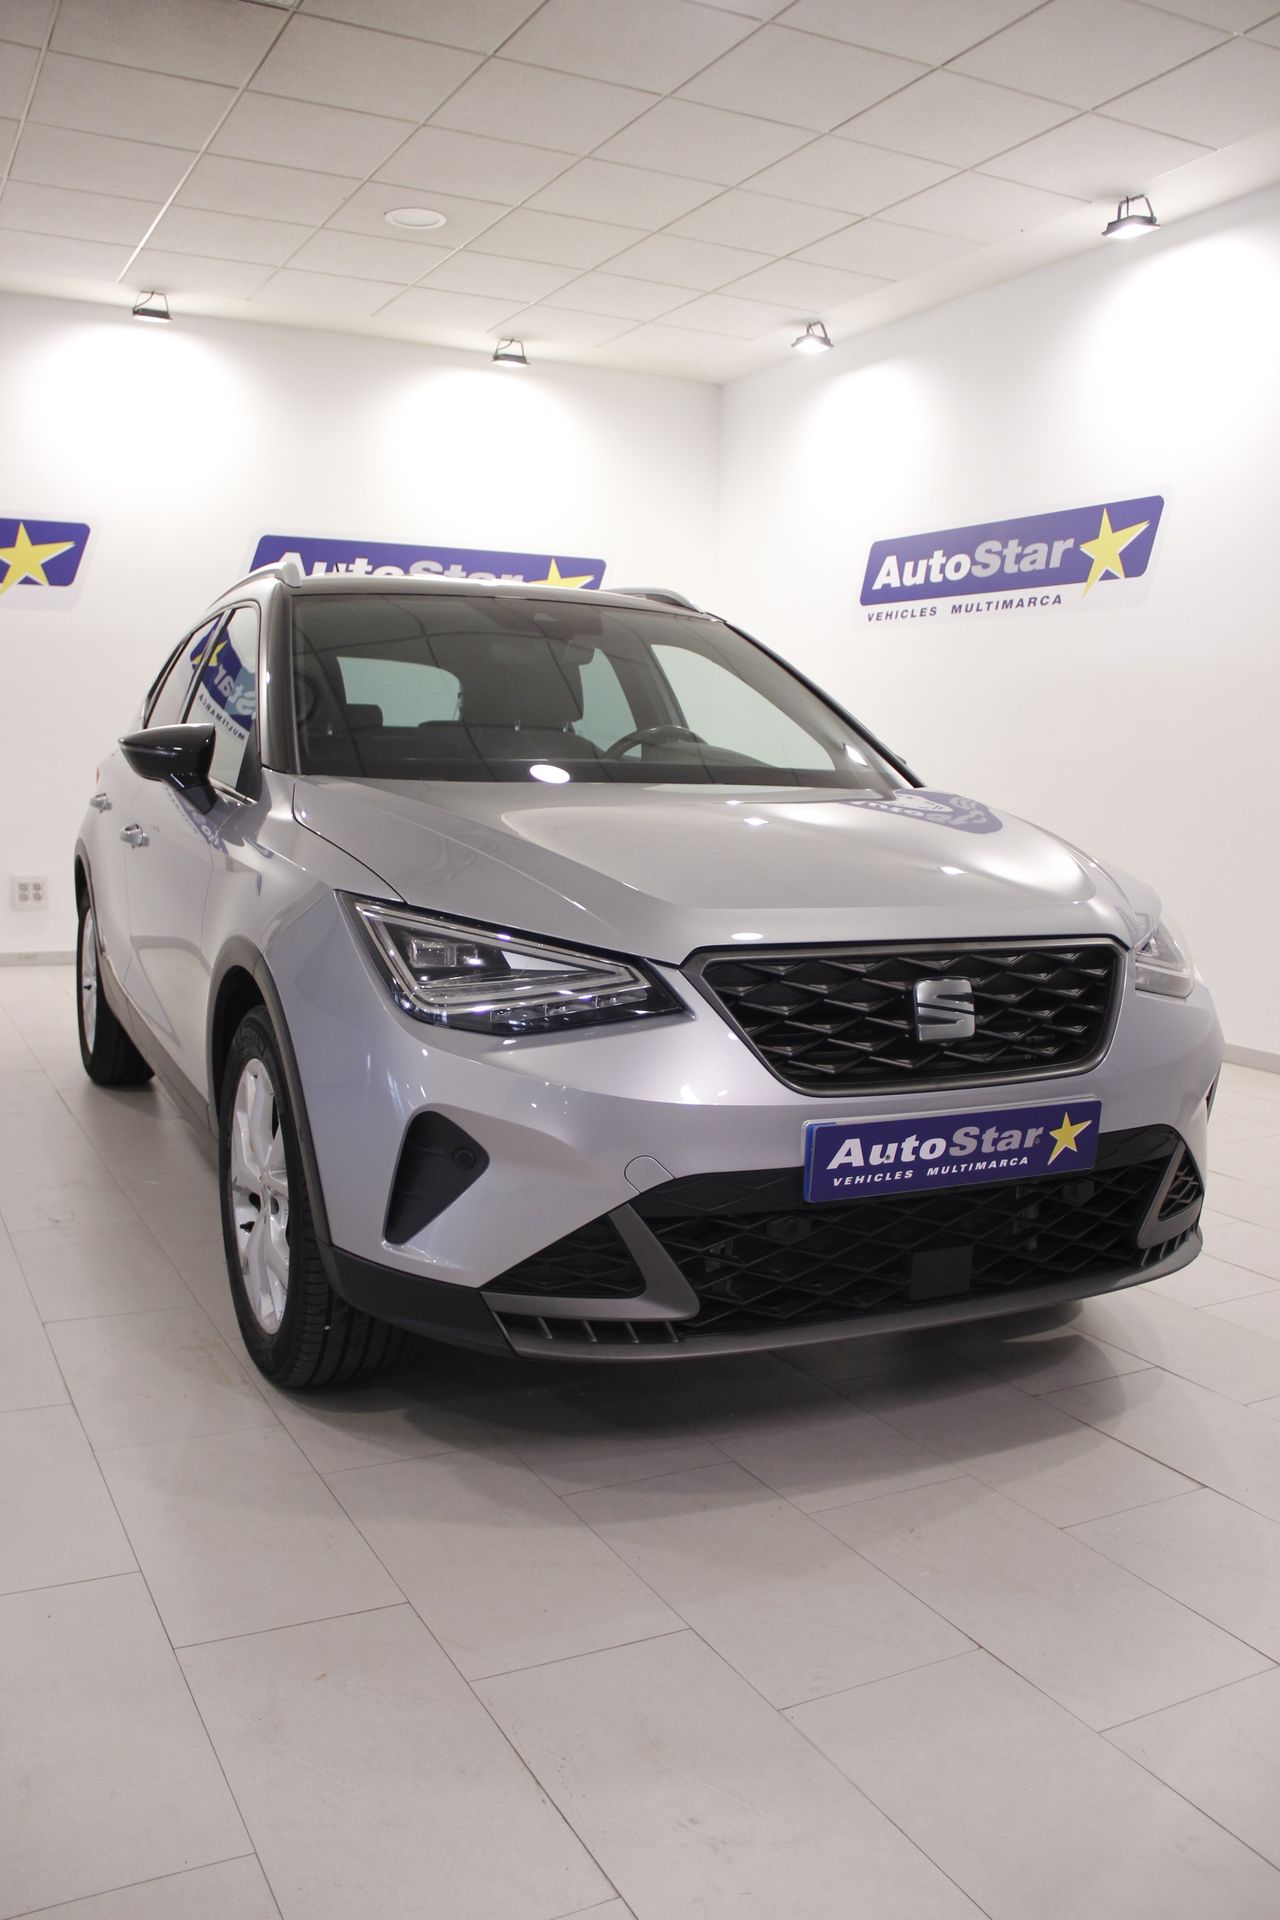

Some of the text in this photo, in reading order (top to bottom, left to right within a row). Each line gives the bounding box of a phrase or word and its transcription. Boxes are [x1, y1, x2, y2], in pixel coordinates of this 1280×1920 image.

[278, 551, 524, 582] AutS
[871, 537, 1075, 590] AutoStar
[867, 594, 1063, 622] VEHICLES MULTIMARCA
[826, 1125, 1043, 1170] AutoStar
[833, 1156, 1029, 1187] VEHICLES MULTIMARCA
